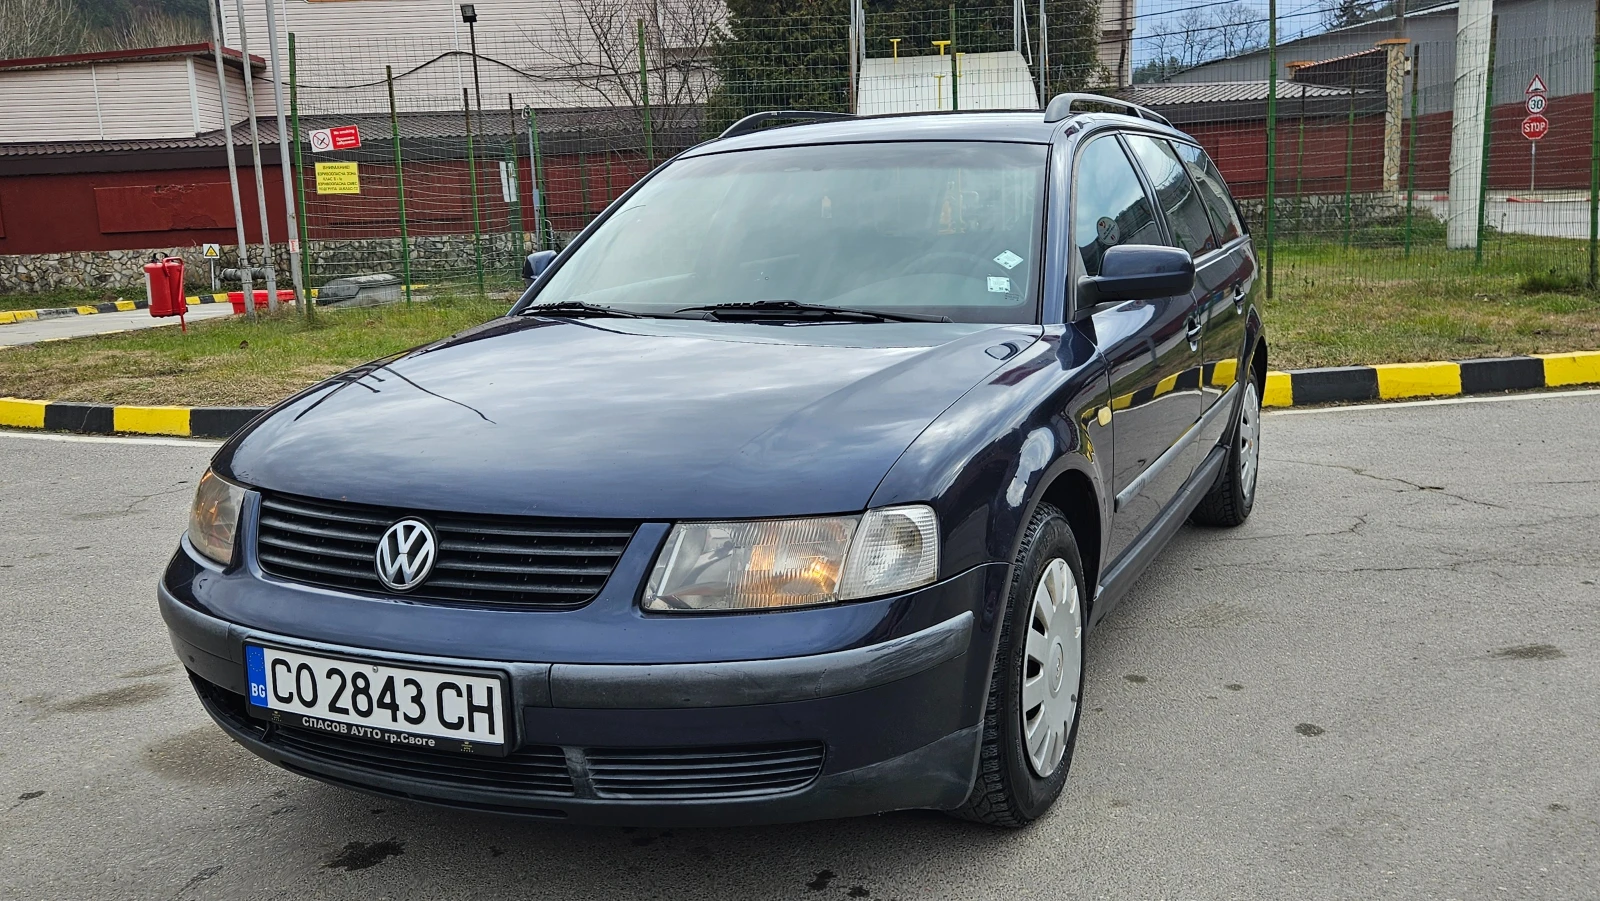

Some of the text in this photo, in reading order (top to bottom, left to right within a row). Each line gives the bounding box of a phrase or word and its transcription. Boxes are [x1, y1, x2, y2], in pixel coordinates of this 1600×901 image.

[1530, 99, 1543, 110] 30
[1524, 121, 1546, 132] STOP
[251, 682, 266, 698] BG
[271, 657, 496, 736] CO 2843 CH
[302, 716, 436, 748] СПАСОВ АУТО гр.Своге
